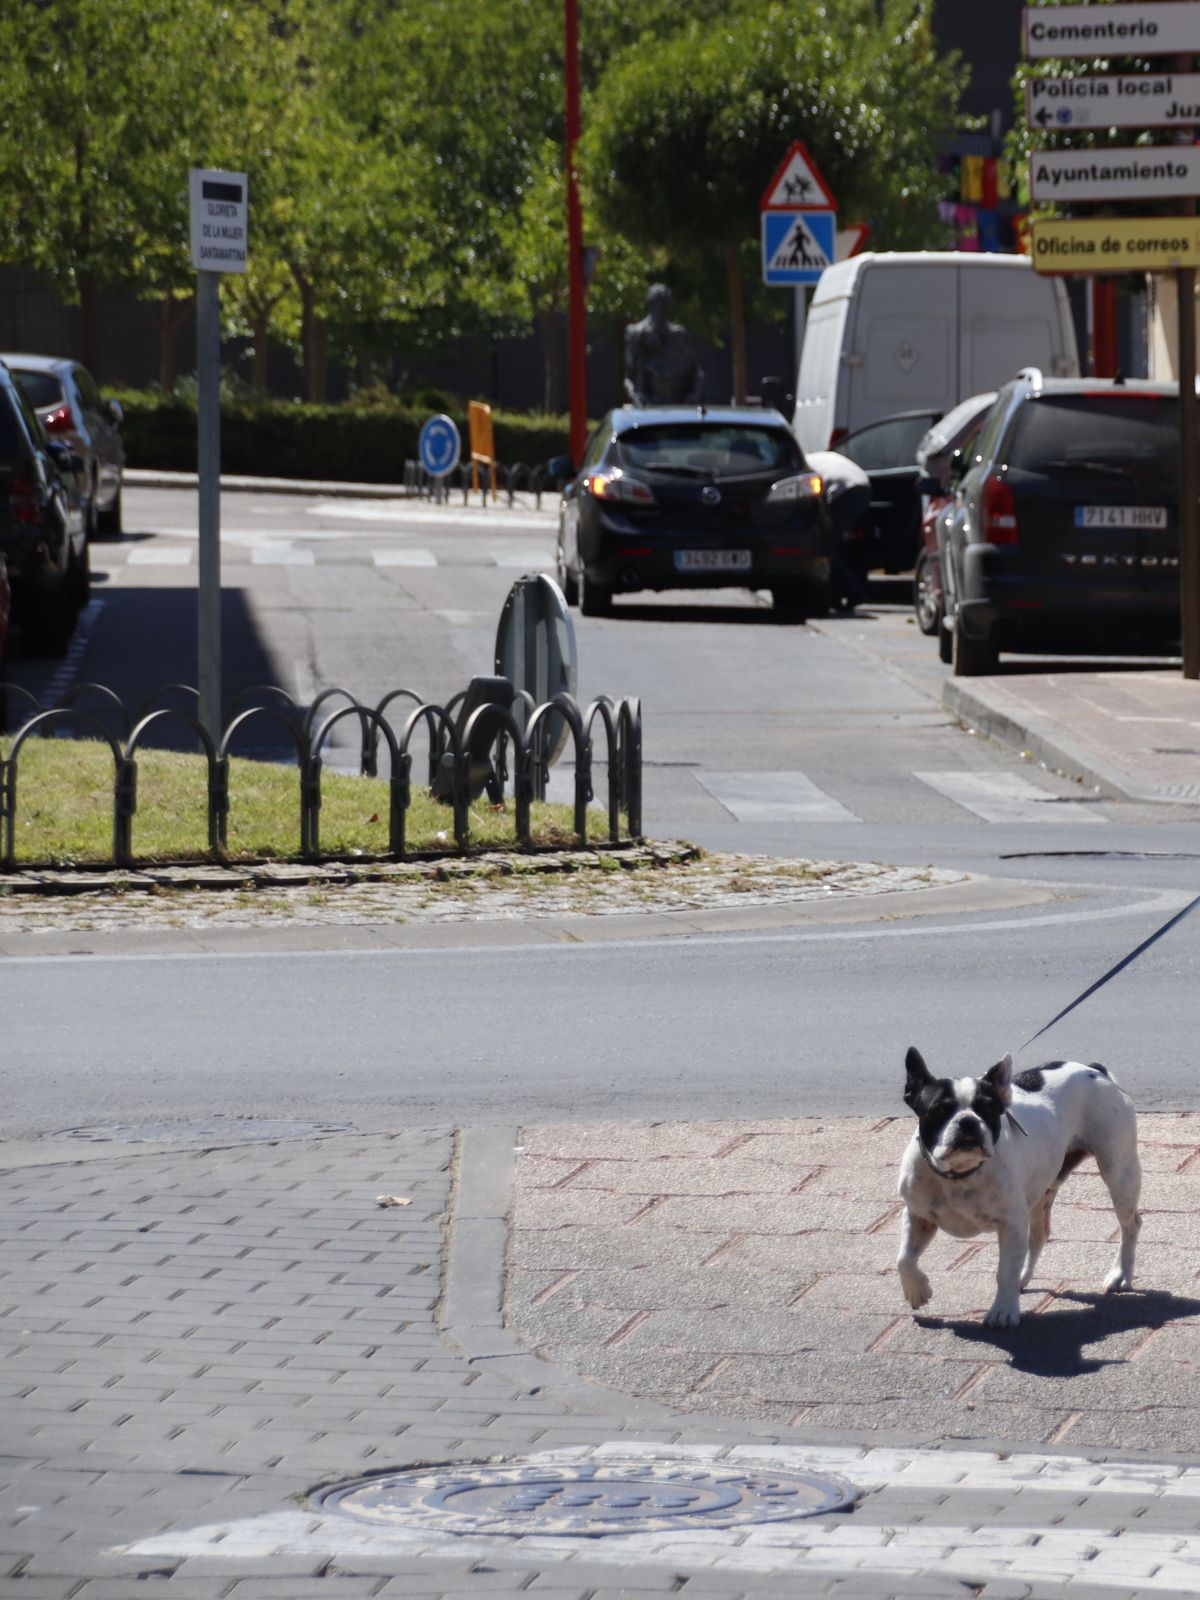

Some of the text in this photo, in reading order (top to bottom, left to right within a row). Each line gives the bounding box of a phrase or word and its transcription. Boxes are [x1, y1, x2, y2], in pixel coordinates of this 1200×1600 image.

[1030, 20, 1159, 40] Cementerio
[1117, 77, 1173, 96] local
[1036, 162, 1188, 186] Ayuntamiento
[202, 224, 212, 238] DE
[1036, 236, 1189, 255] Oficina de correos
[1085, 508, 1164, 524] 7141 HHV
